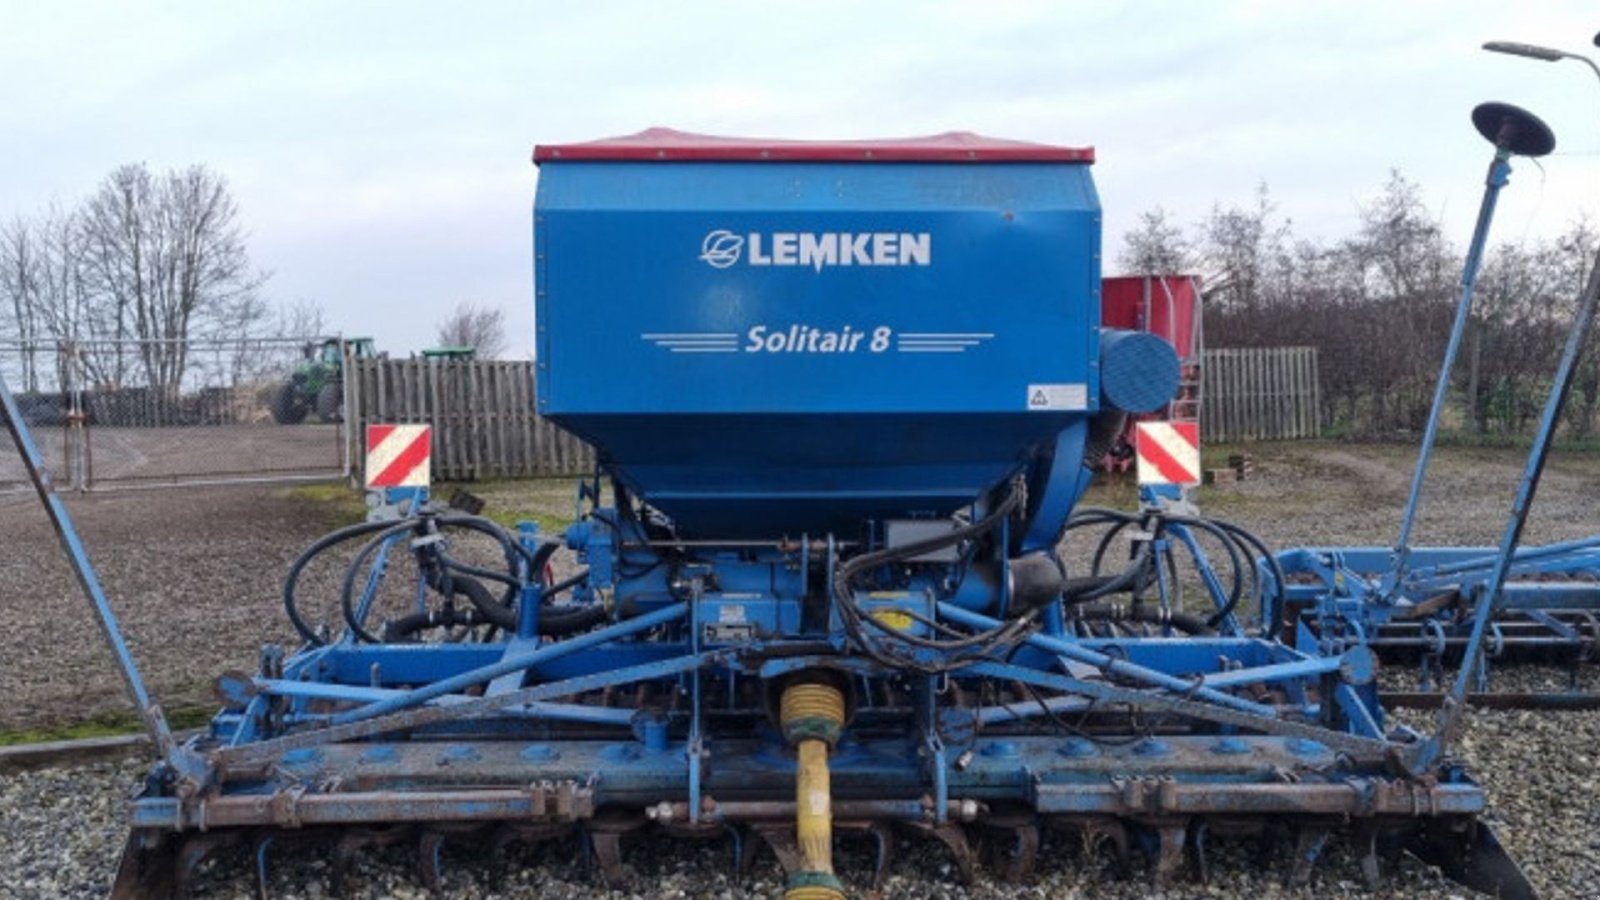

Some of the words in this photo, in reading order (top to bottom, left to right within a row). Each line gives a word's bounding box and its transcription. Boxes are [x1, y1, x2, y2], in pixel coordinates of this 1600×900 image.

[748, 232, 931, 273] LEMKEN
[745, 325, 864, 353] Solitair
[869, 326, 892, 353] 8
